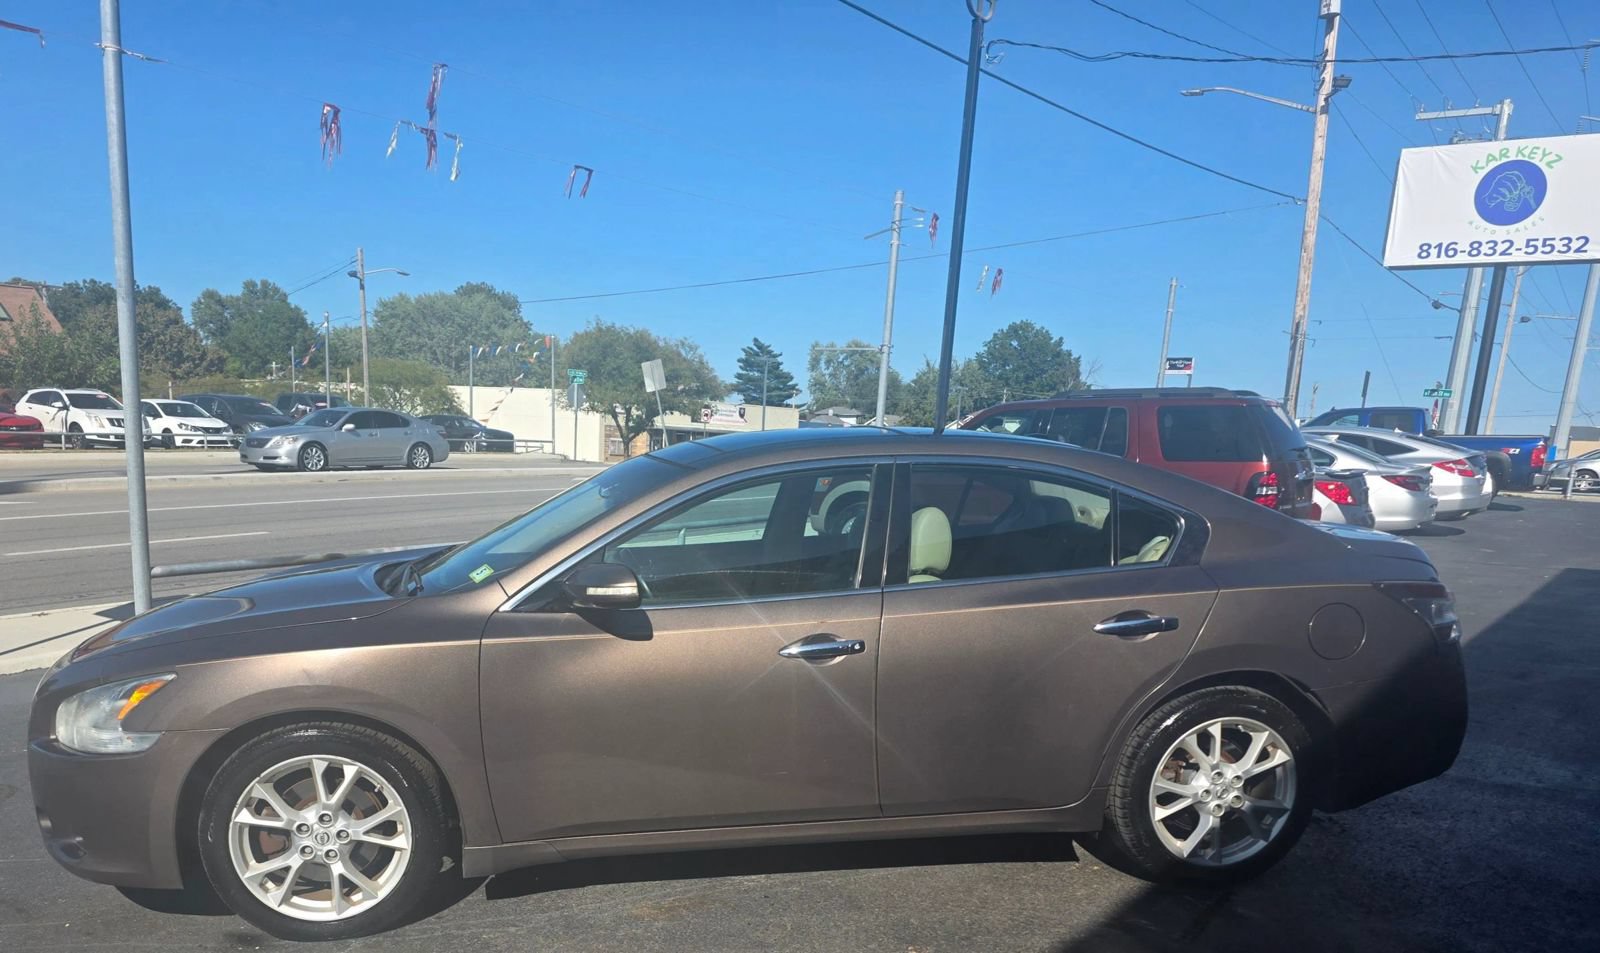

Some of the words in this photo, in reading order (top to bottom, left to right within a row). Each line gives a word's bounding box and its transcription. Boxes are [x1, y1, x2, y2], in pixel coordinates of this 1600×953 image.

[1470, 147, 1510, 174] KAR
[1515, 145, 1563, 169] KEYZ
[1467, 220, 1496, 235] AUTO
[1506, 216, 1544, 235] SALES
[1417, 235, 1590, 260] 816-832-5532
